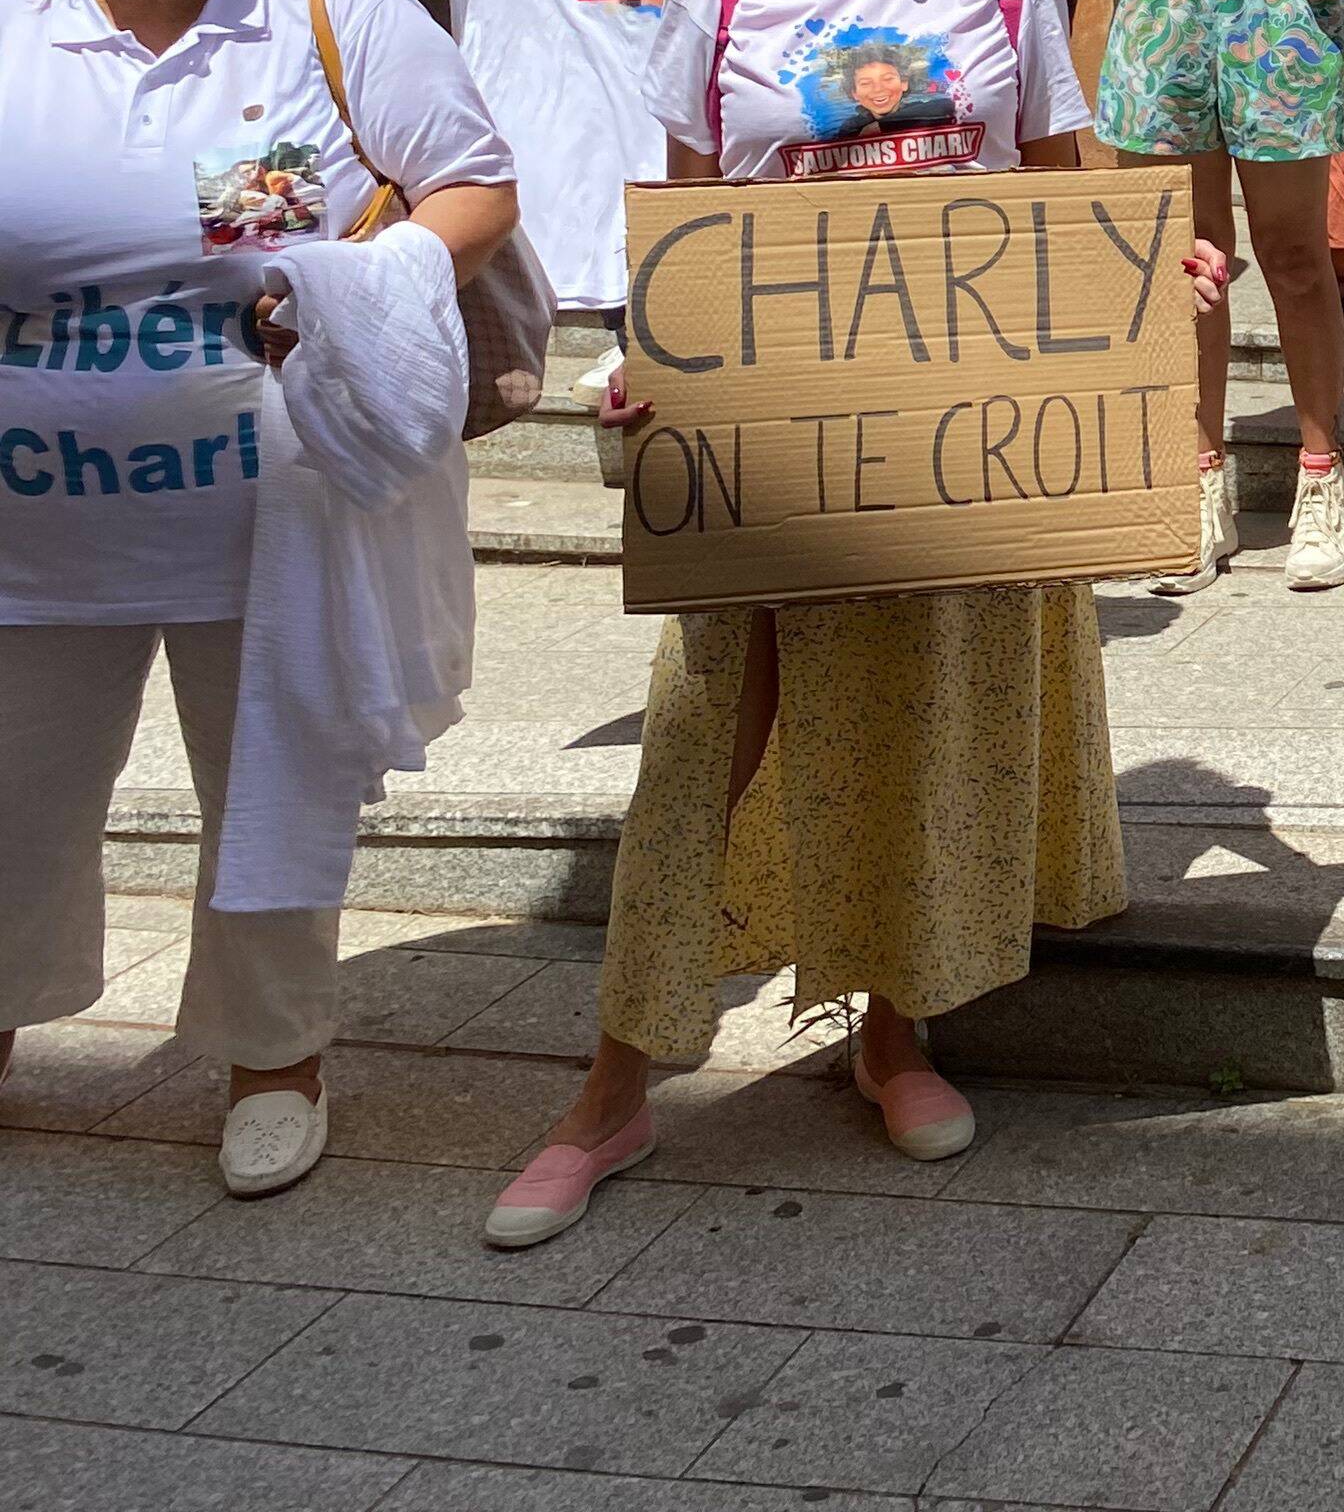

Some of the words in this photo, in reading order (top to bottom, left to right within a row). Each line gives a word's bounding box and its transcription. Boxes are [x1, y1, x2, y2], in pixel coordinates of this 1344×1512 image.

[790, 140, 897, 176] SAUVONS
[632, 189, 1172, 374] CHARLY
[0, 412, 260, 497] Charl
[632, 425, 742, 537] ON
[790, 410, 898, 513] TE
[932, 385, 1170, 506] CROIT
